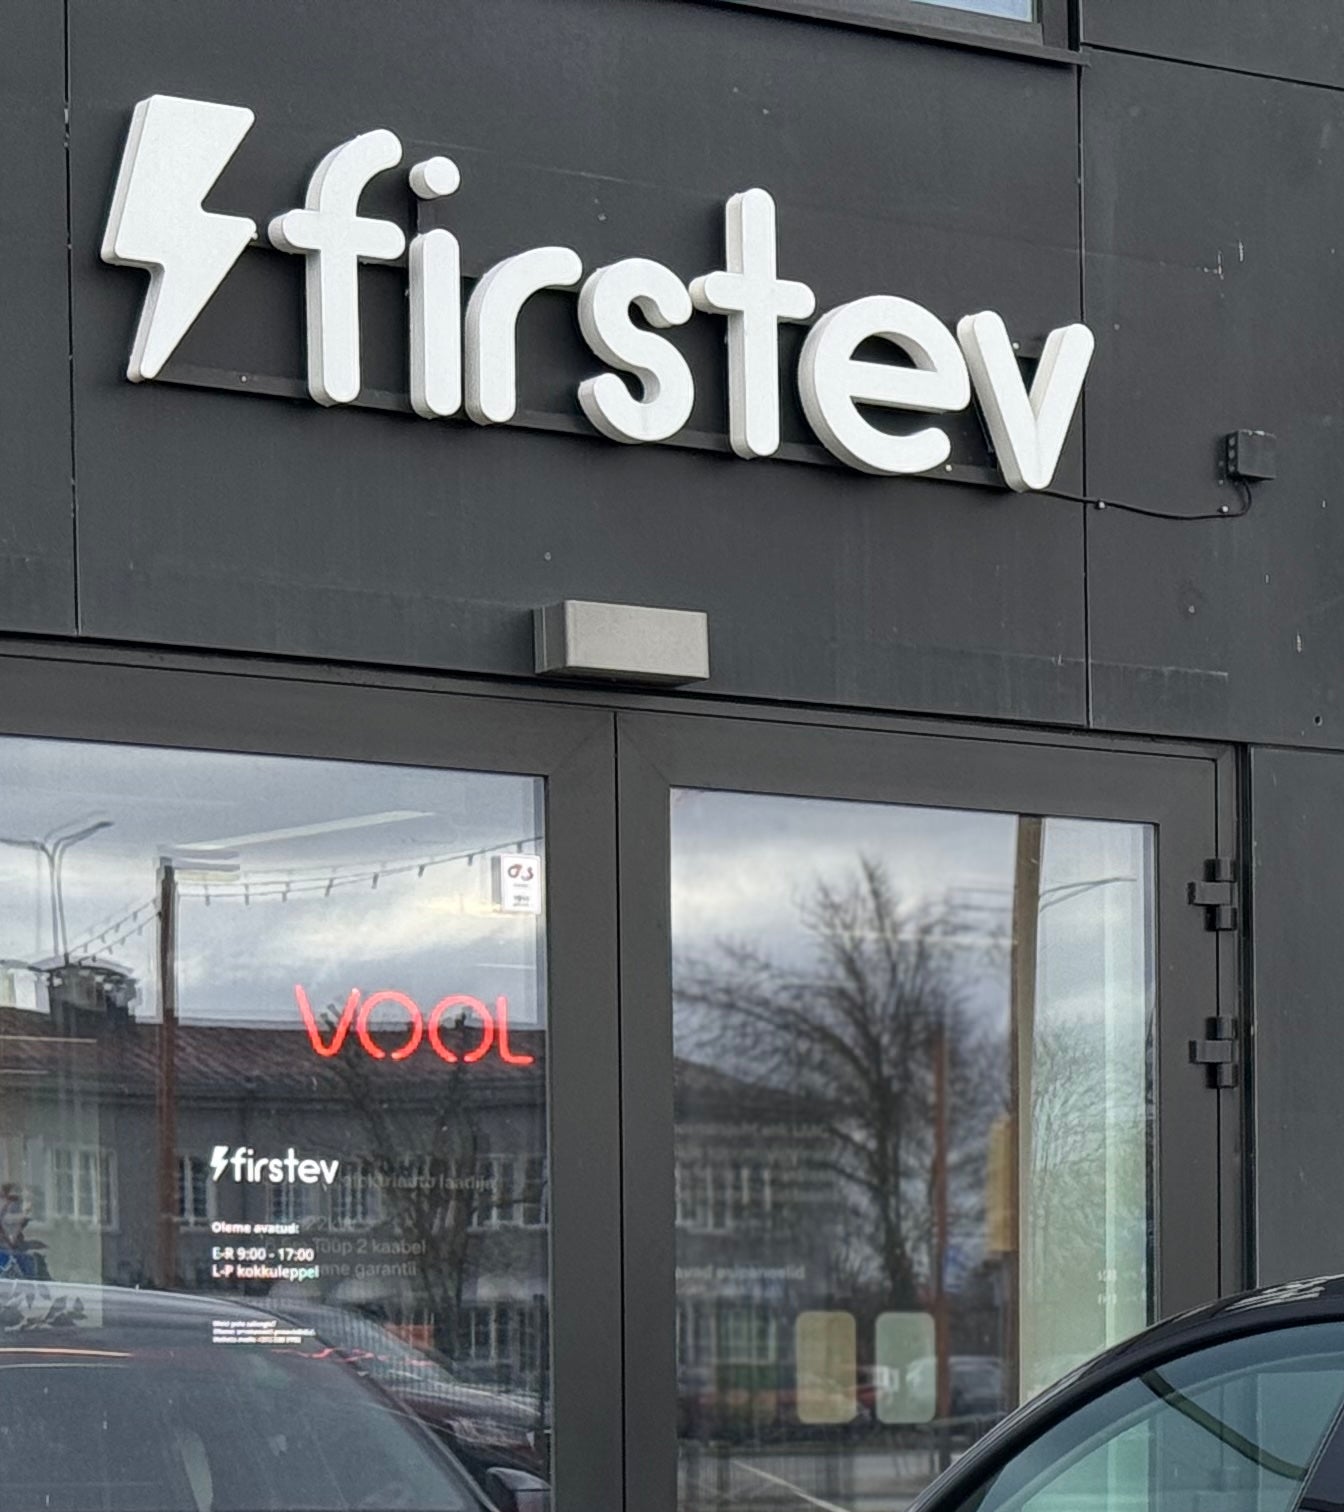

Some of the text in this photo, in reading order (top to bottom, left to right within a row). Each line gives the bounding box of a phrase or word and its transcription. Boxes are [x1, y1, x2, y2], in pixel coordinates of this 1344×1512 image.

[269, 129, 1095, 491] firstev
[294, 983, 535, 1065] VOOL
[231, 1147, 340, 1184] firstev
[211, 1221, 300, 1235] Oleme avatud:
[237, 1247, 268, 1262] 9:00
[277, 1248, 315, 1262] 17:00
[236, 1265, 320, 1282] kokkuleppel
